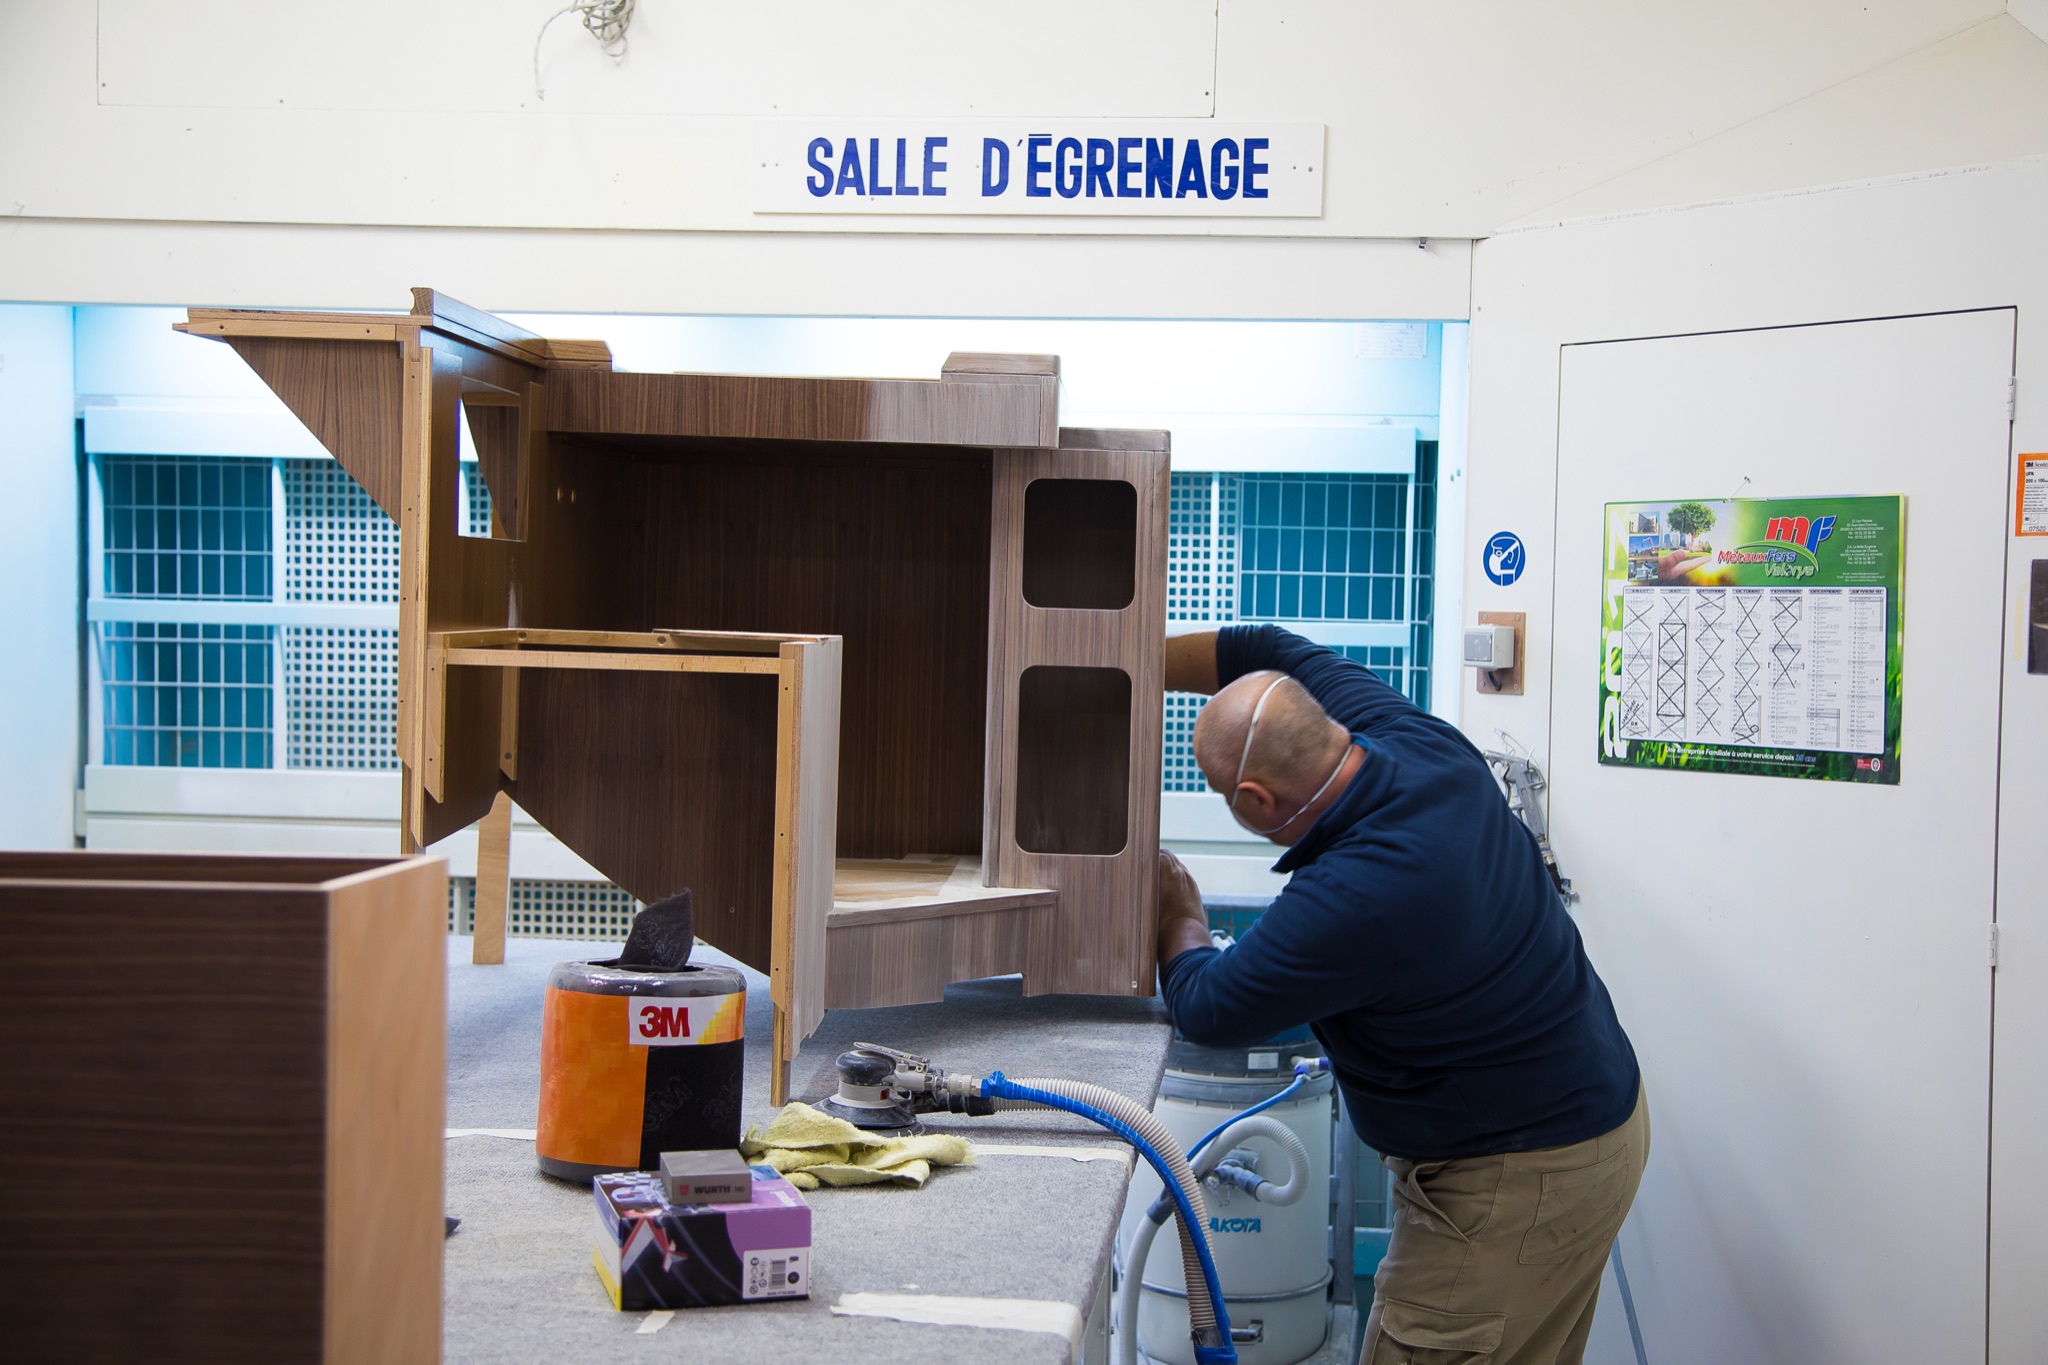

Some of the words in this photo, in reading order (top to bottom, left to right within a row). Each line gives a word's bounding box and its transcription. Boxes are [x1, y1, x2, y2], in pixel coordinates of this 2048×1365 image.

[806, 136, 948, 198] SALLE
[1775, 752, 1795, 762] depuis
[638, 1006, 690, 1038] 3M
